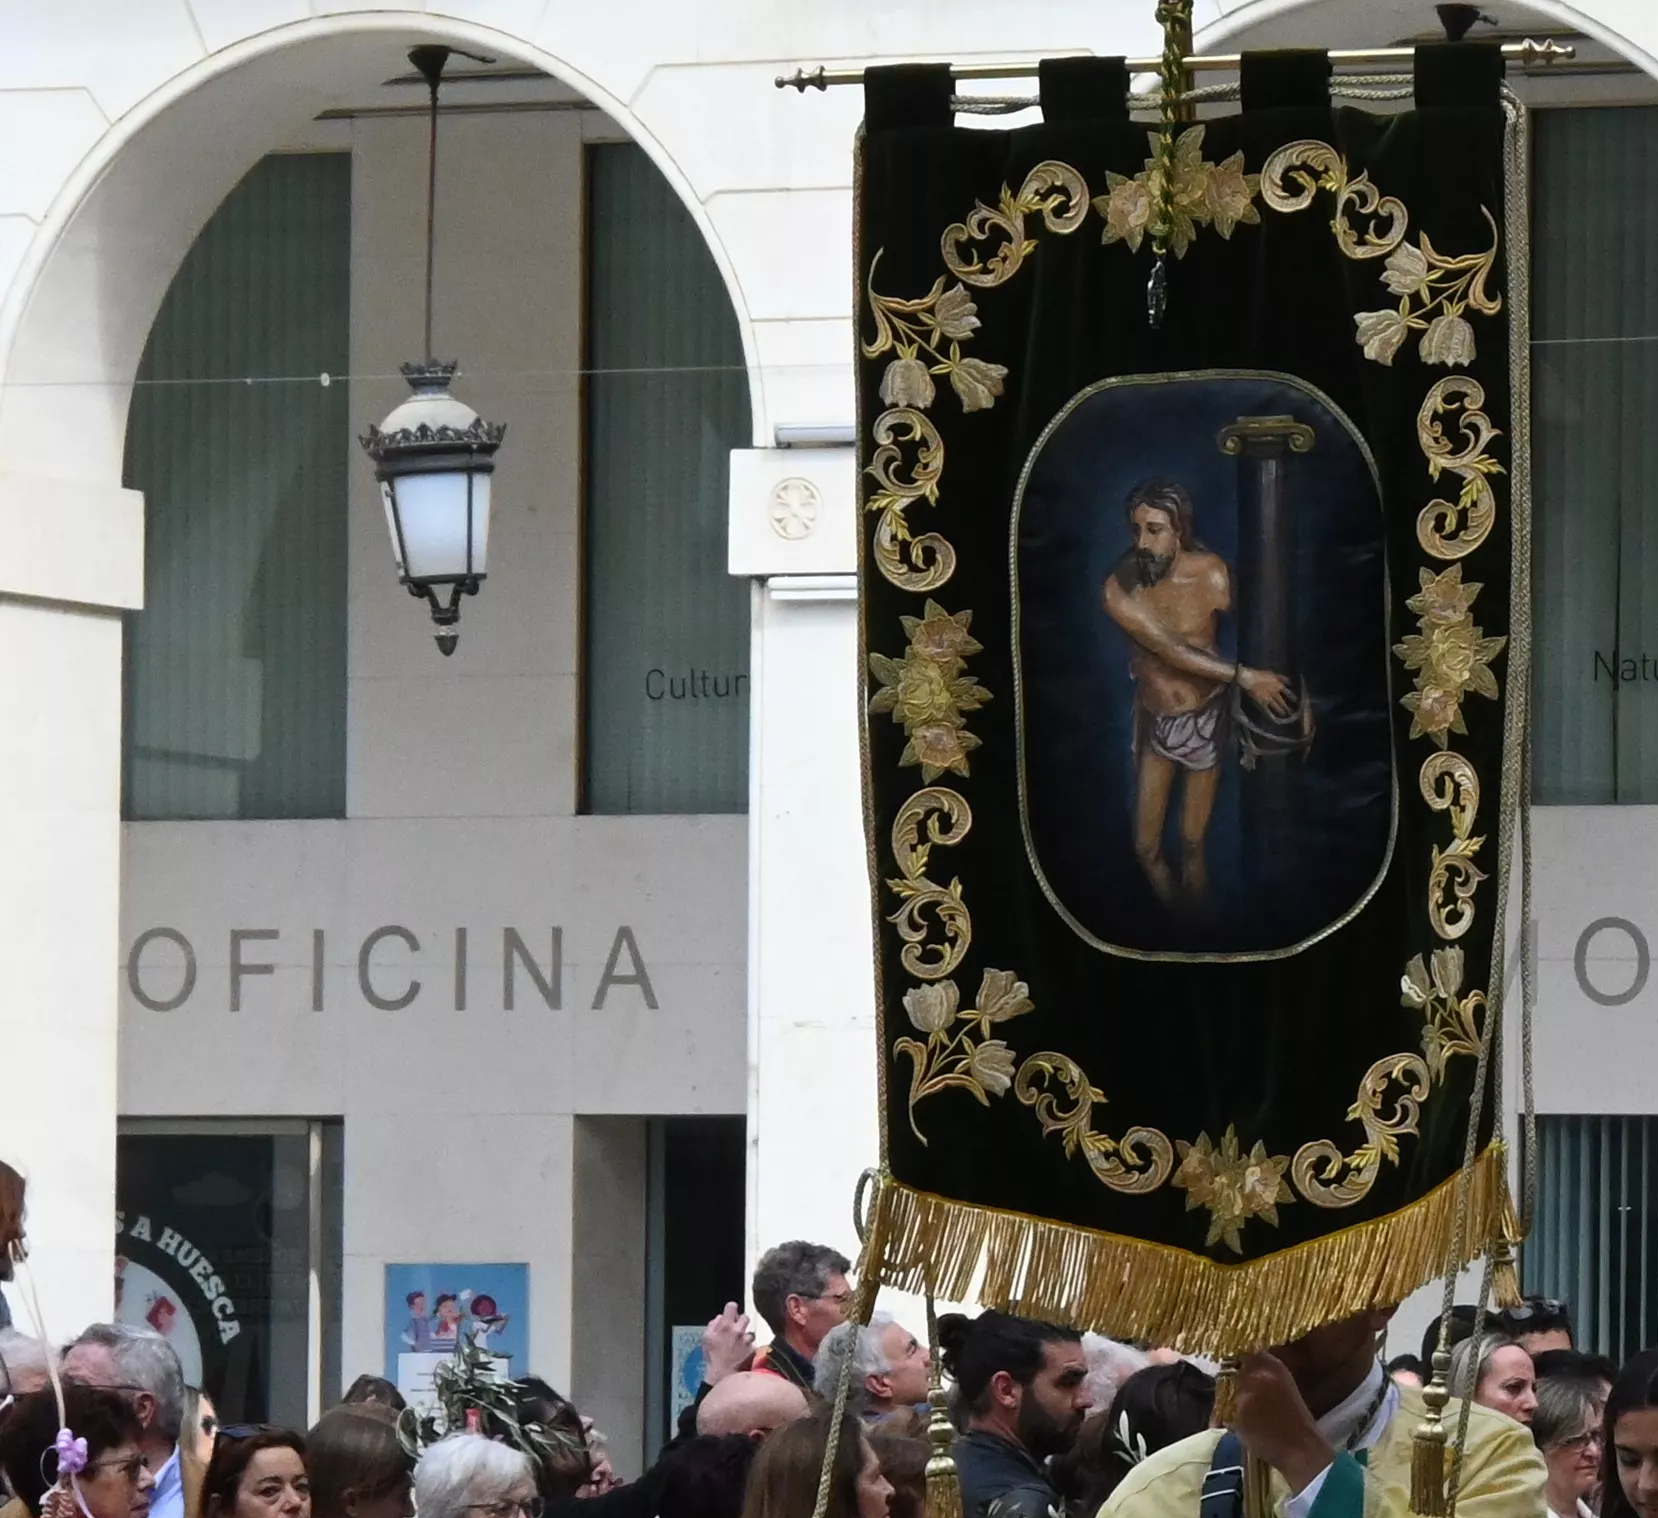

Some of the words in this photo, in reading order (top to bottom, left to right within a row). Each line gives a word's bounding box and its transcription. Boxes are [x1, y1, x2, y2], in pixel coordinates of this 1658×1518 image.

[645, 667, 749, 700] Cultur
[127, 924, 659, 1012] OFICINA
[129, 1214, 152, 1242] A
[156, 1226, 241, 1345] HUESCA
